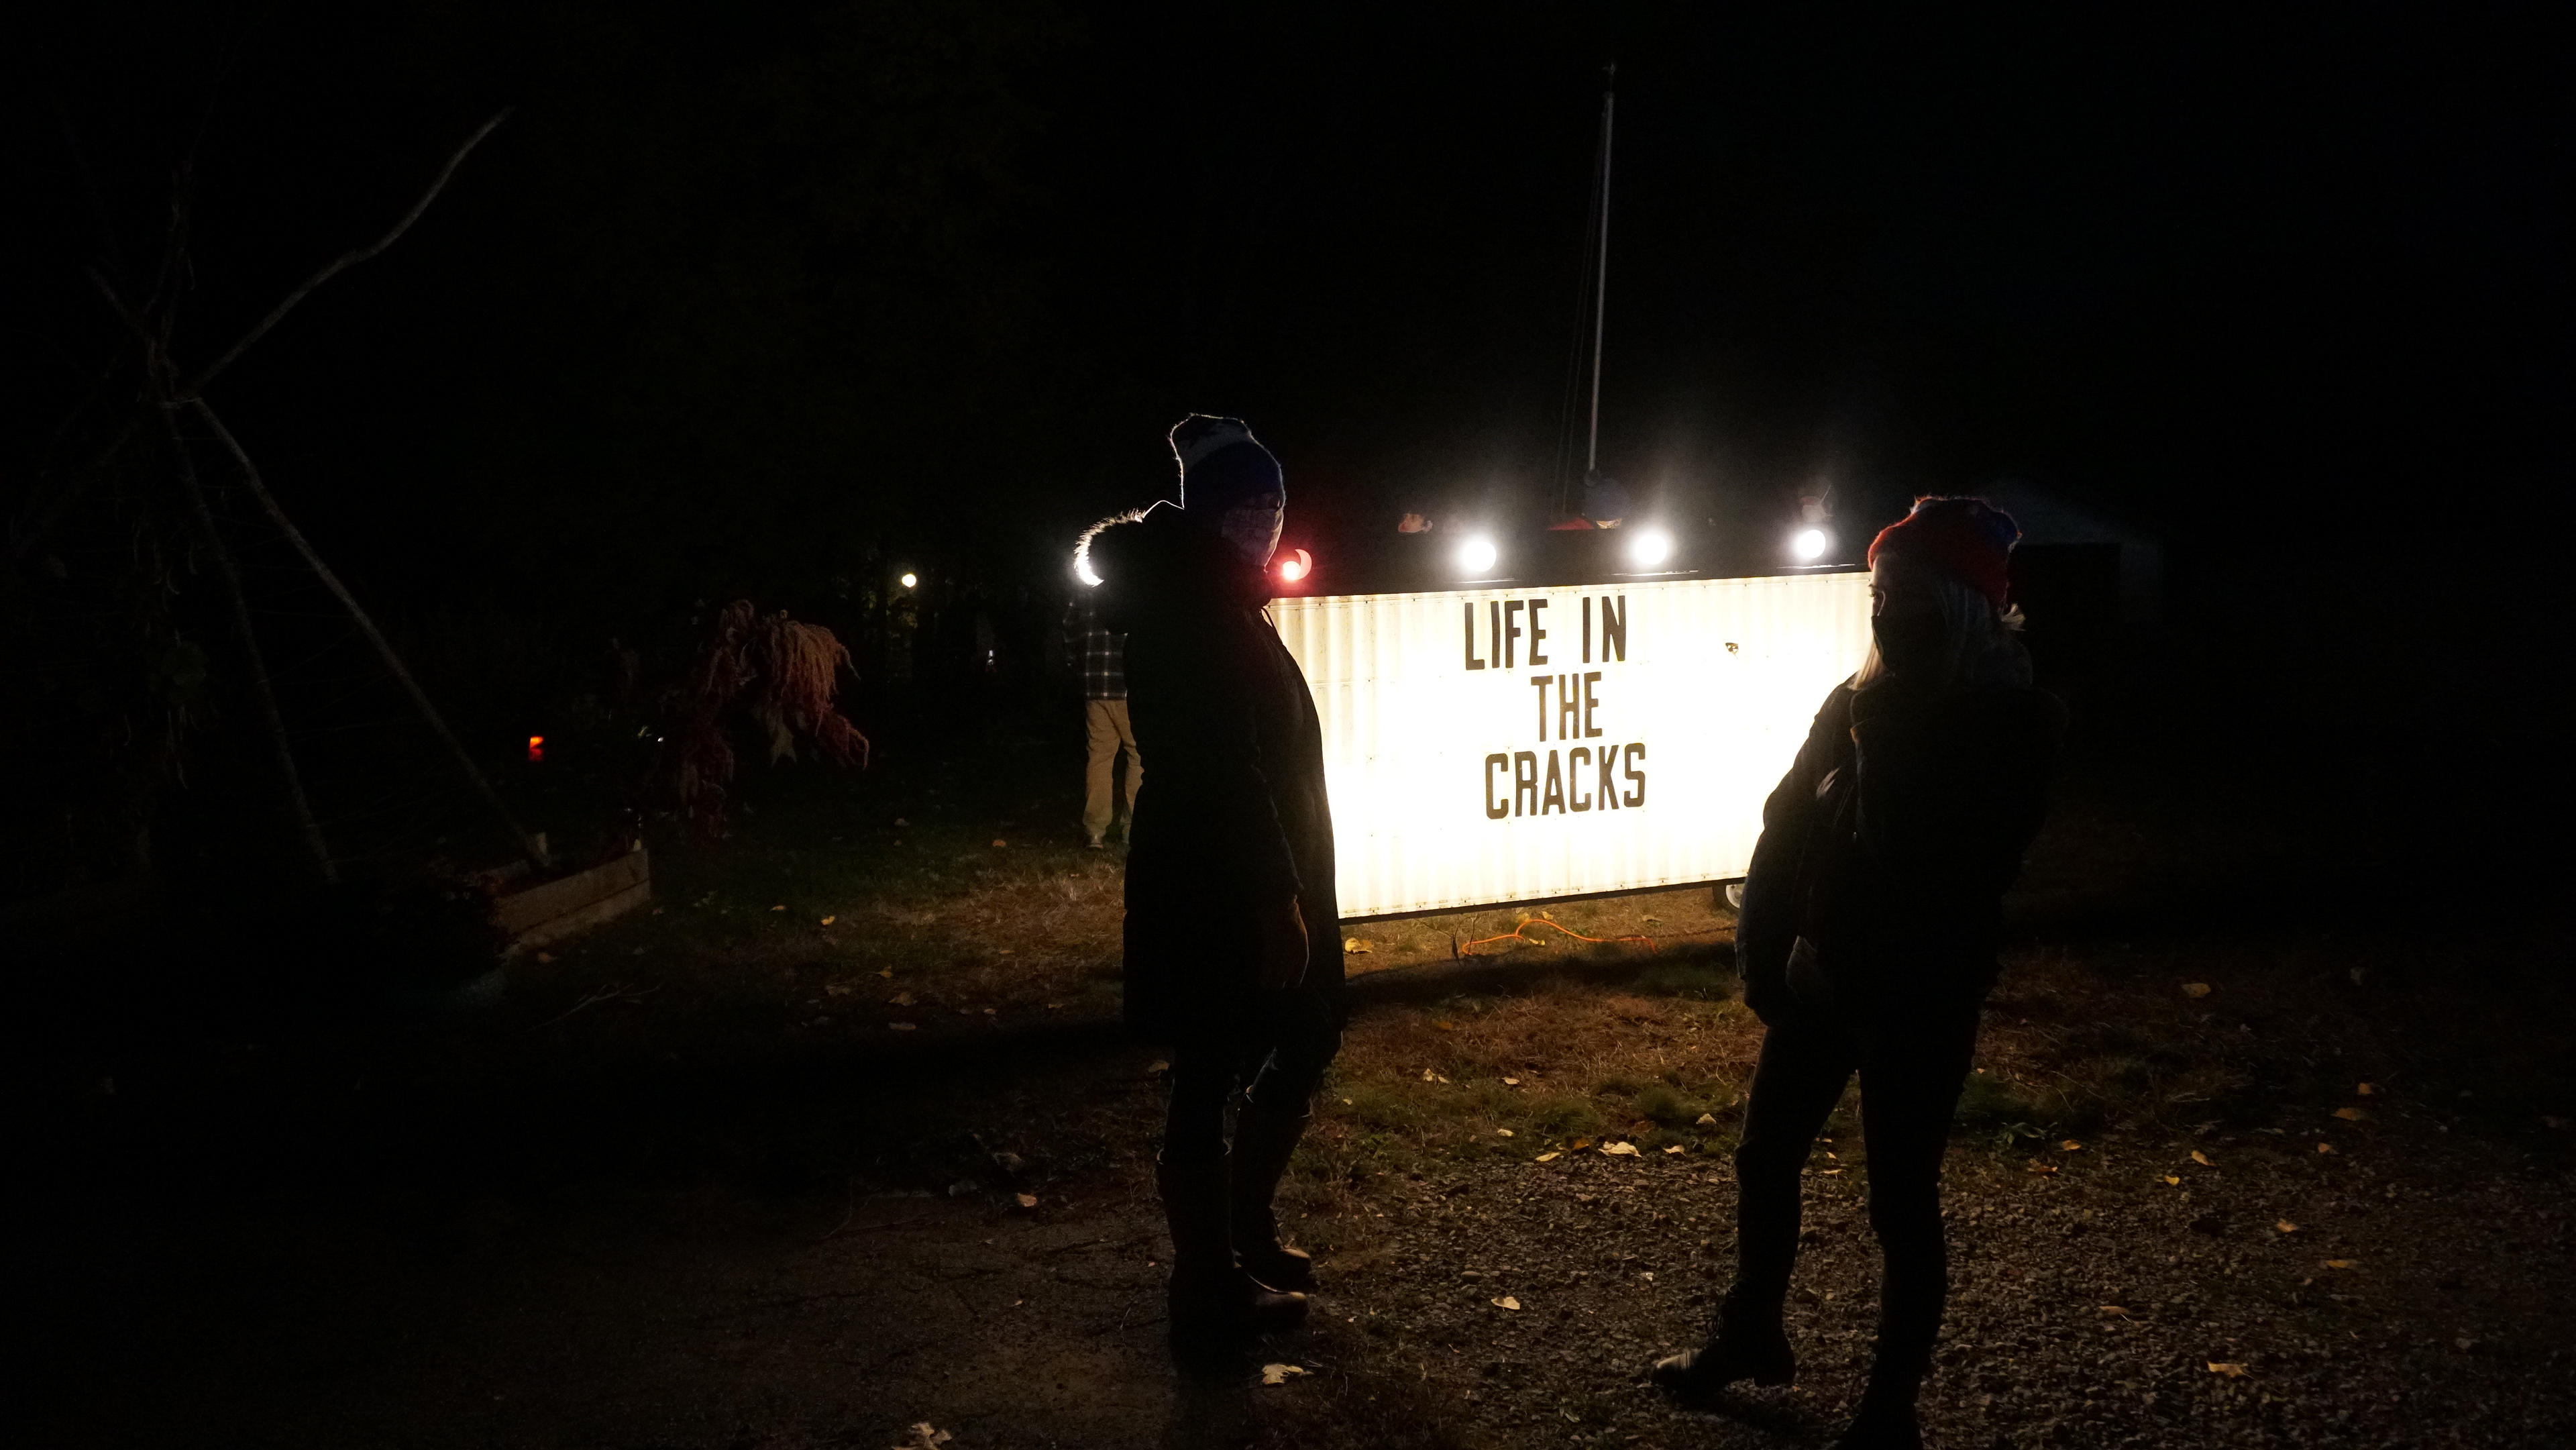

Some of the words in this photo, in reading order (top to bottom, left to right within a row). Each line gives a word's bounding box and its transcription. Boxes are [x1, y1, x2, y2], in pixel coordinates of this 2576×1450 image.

[1464, 599, 1548, 670] LIFE
[1582, 595, 1626, 664] IN
[1531, 672, 1603, 742] THE
[1485, 743, 1646, 819] CRACKS
